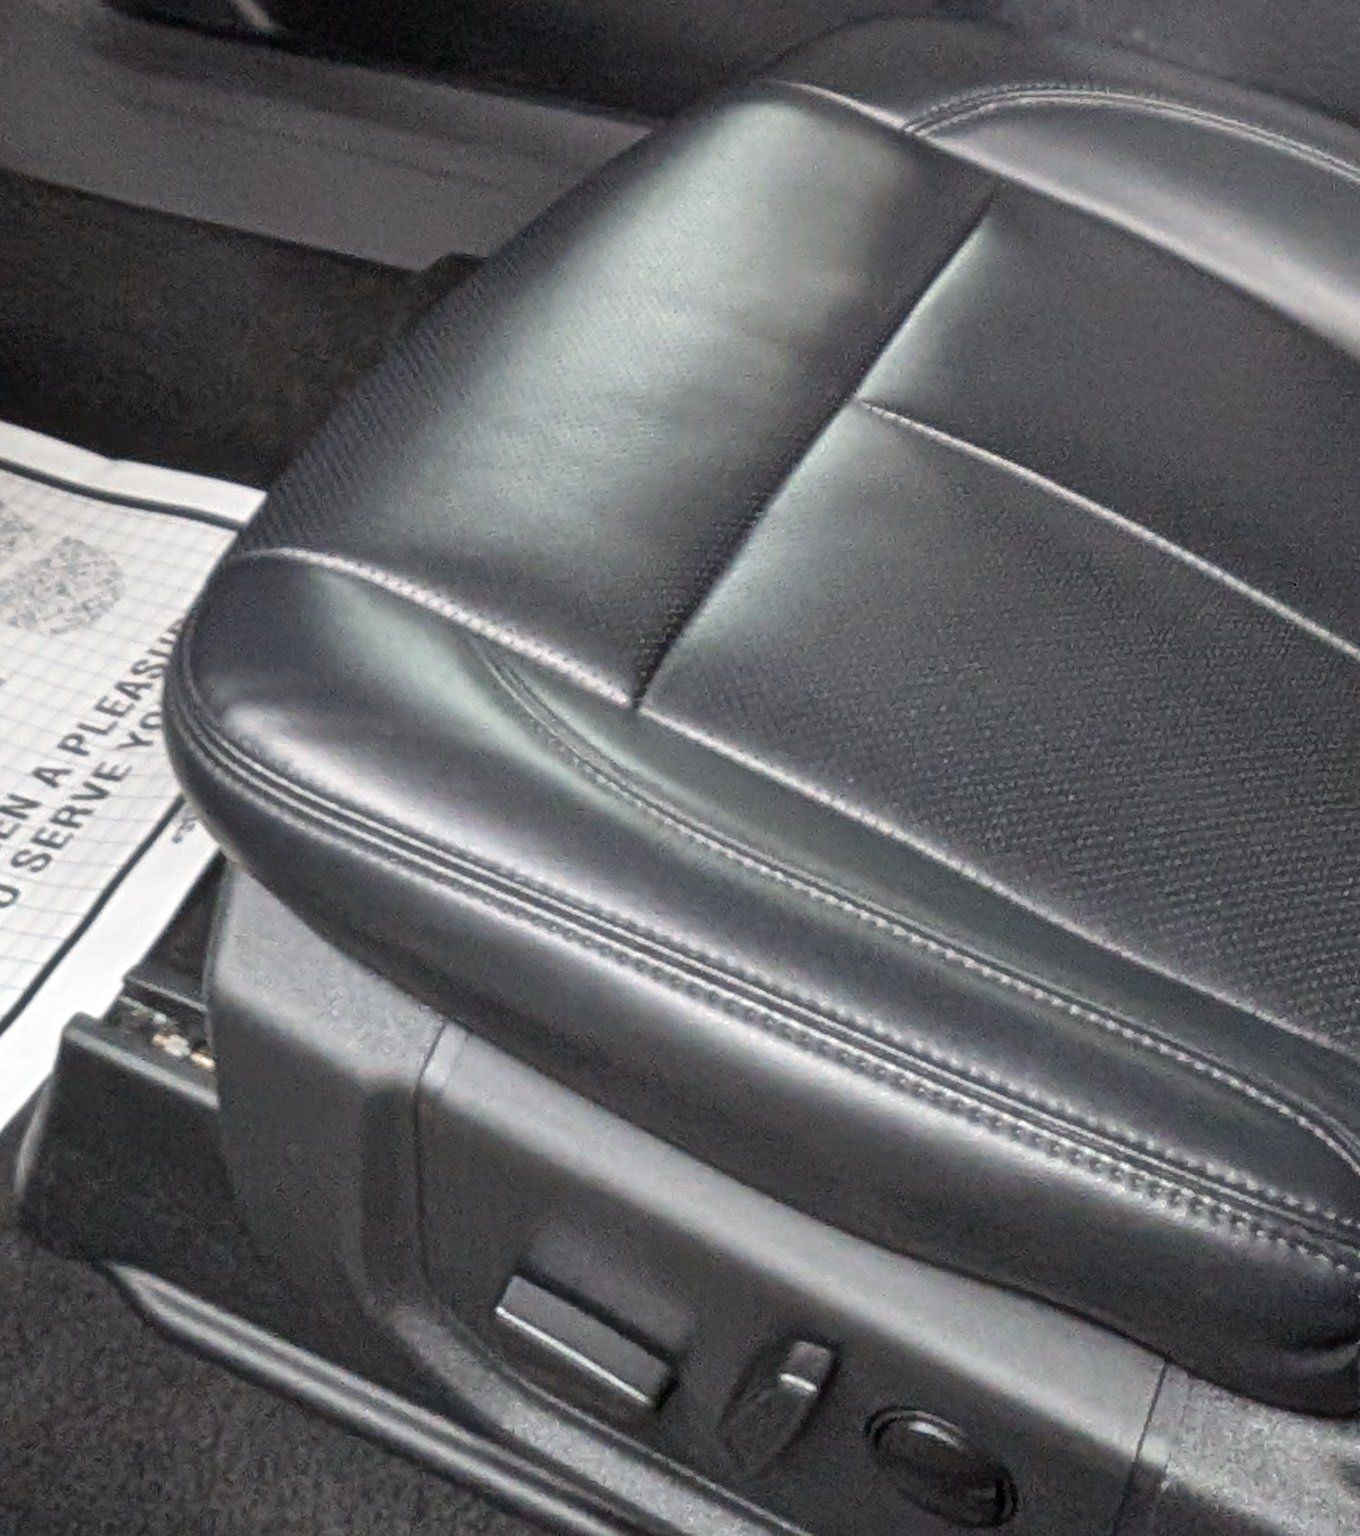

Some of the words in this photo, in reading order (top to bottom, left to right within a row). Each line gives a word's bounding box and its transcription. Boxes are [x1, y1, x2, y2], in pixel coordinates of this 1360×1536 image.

[10, 759, 133, 875] SERVE
[114, 700, 164, 751] YO
[31, 764, 72, 789] A
